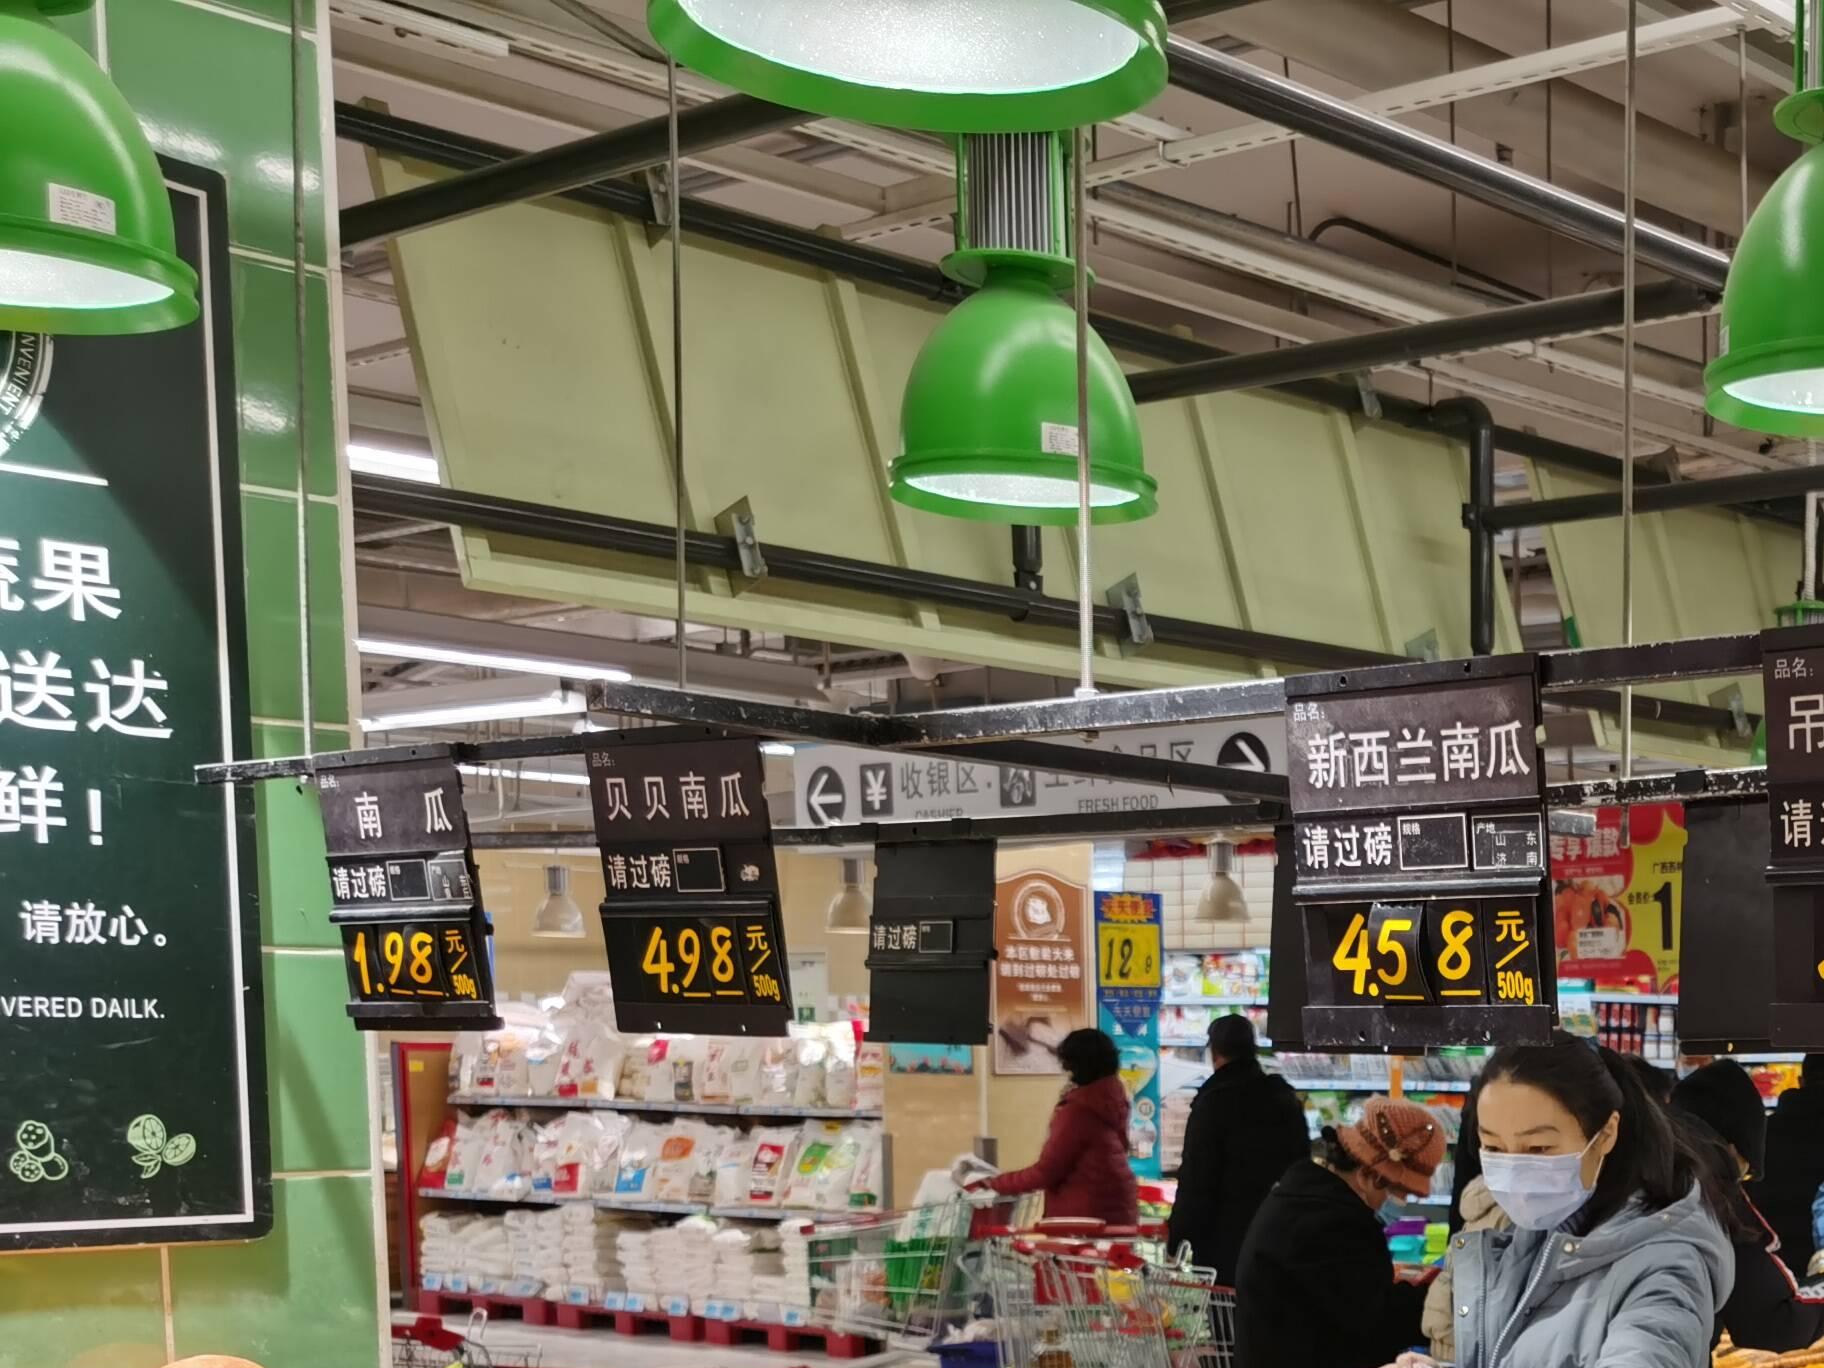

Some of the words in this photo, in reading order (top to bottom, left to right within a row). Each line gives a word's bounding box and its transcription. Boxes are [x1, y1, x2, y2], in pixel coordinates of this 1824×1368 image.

[1307, 720, 1531, 789] 新西兰南瓜
[605, 770, 751, 821] 贝贝南瓜
[1077, 798, 1119, 813] FRESH
[1122, 795, 1159, 811] FOOD
[354, 788, 453, 839] 南瓜
[1402, 823, 1421, 836] 规格
[1475, 822, 1496, 835] 产地
[1303, 822, 1393, 870] 请过磅
[1495, 831, 1538, 848] 山东
[333, 866, 387, 900] 请过磅
[608, 853, 672, 890] 请过磅
[18, 900, 167, 947] 请放心。
[873, 924, 918, 951] 请过磅
[354, 932, 434, 995] 1.98
[642, 926, 735, 995] 4.98
[1332, 910, 1475, 997] 4.58
[452, 973, 478, 999] 500g
[751, 973, 781, 1001] 500g
[1497, 971, 1535, 1006] 500g
[0, 996, 83, 1018] VERED
[91, 997, 165, 1019] DAILK.
